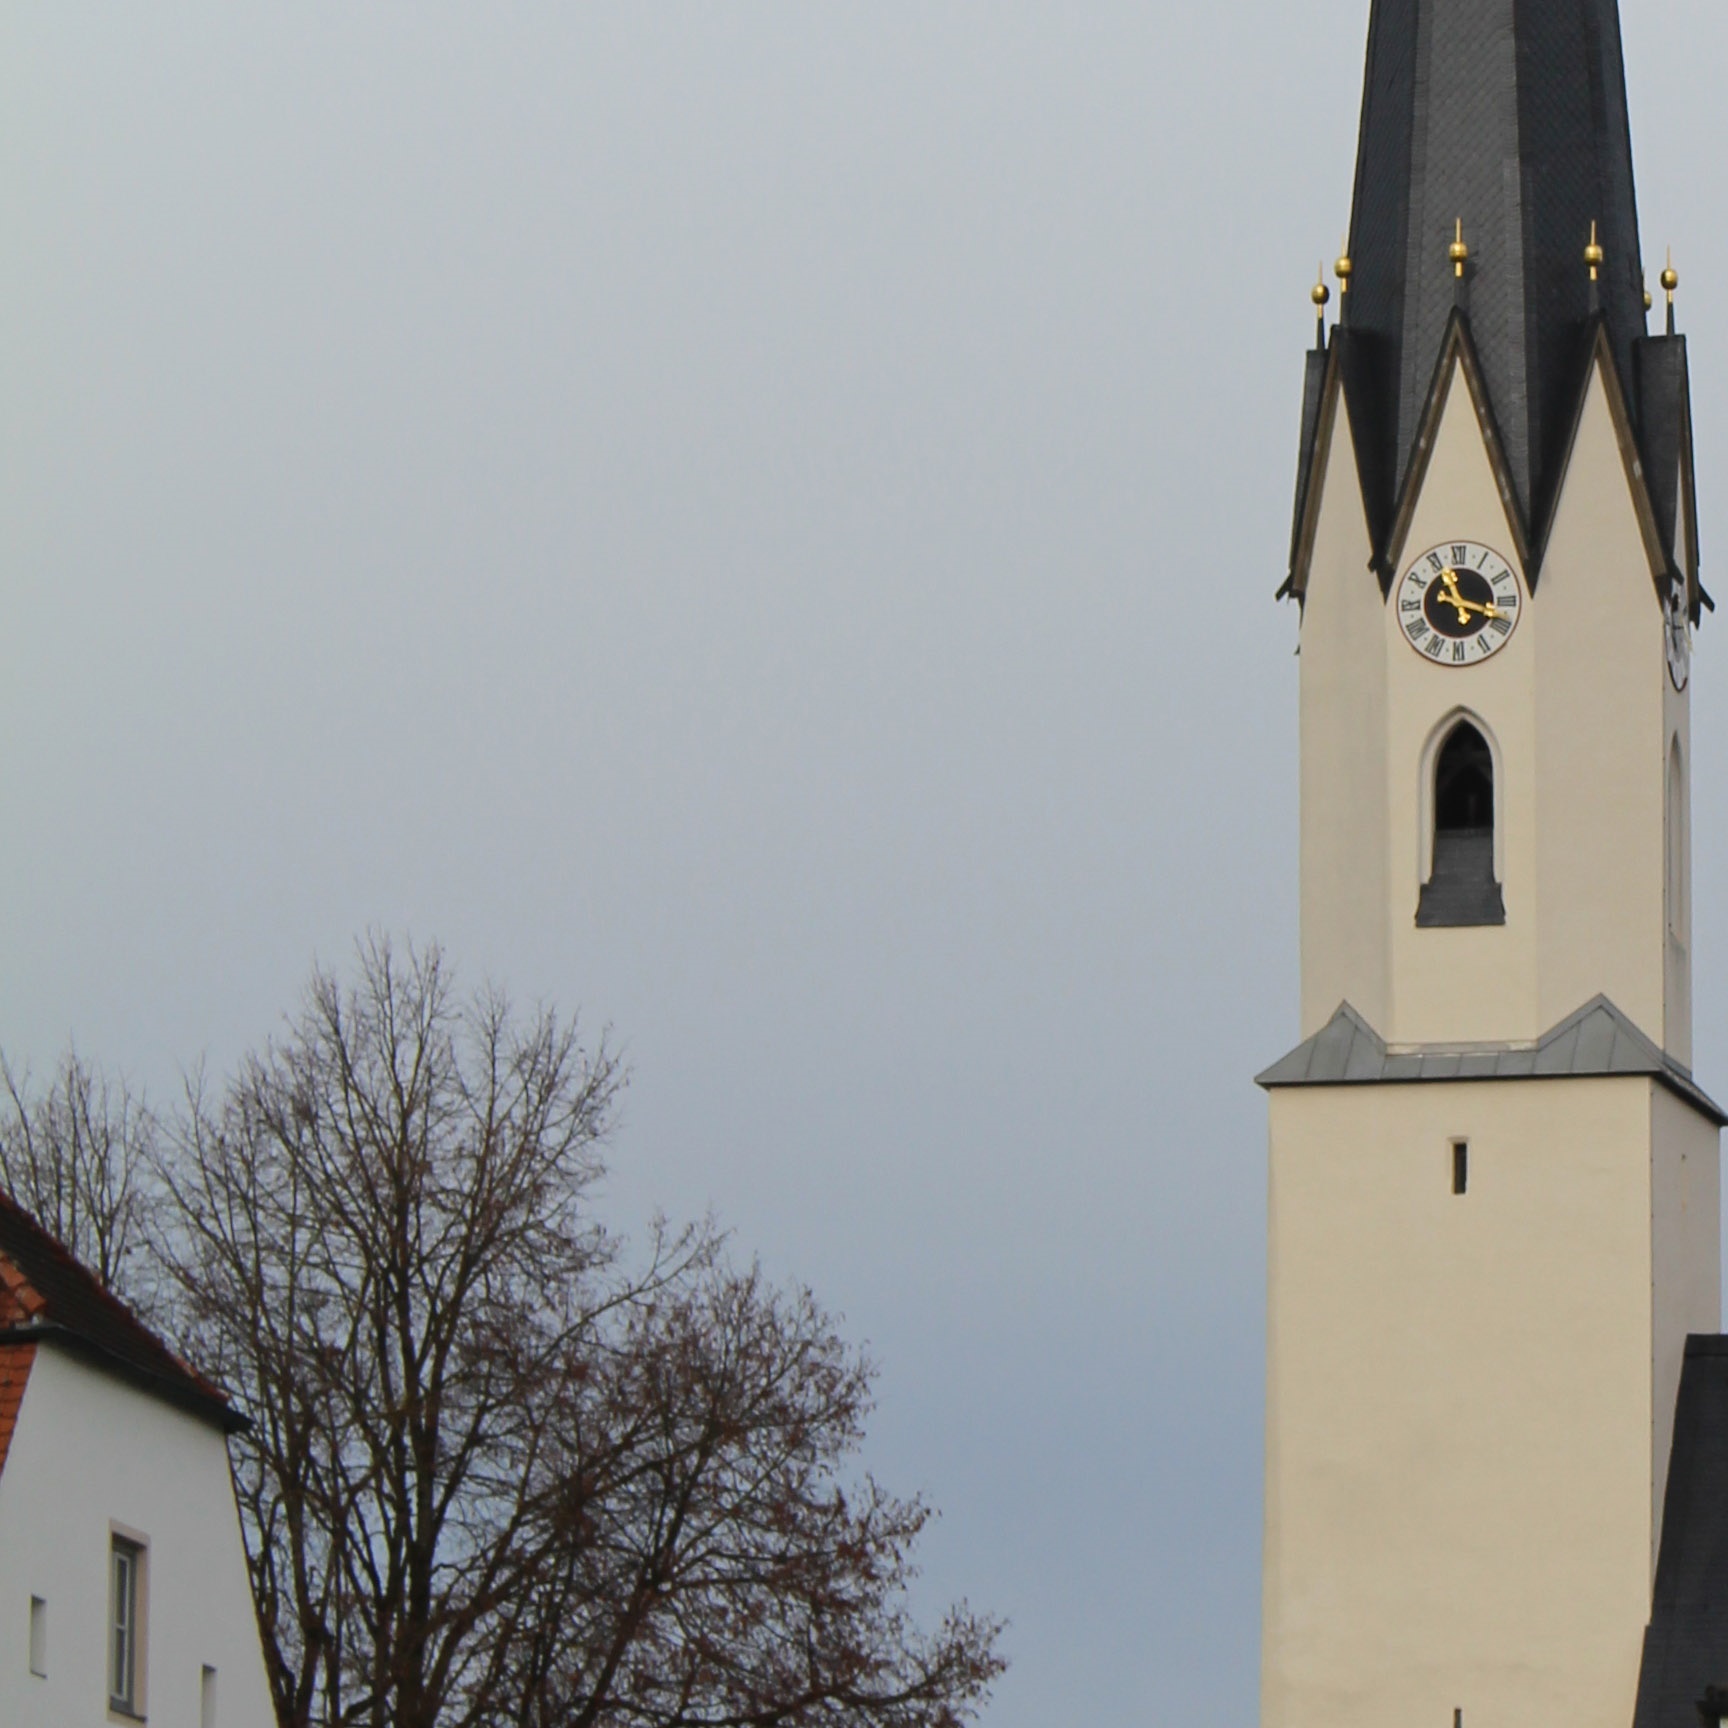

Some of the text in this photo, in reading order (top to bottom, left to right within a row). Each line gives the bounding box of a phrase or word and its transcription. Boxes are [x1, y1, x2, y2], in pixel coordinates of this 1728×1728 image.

[1451, 545, 1467, 565] XII
[1477, 551, 1489, 570] I
[1408, 572, 1427, 589] X
[1490, 569, 1511, 586] II
[1497, 595, 1517, 607] III
